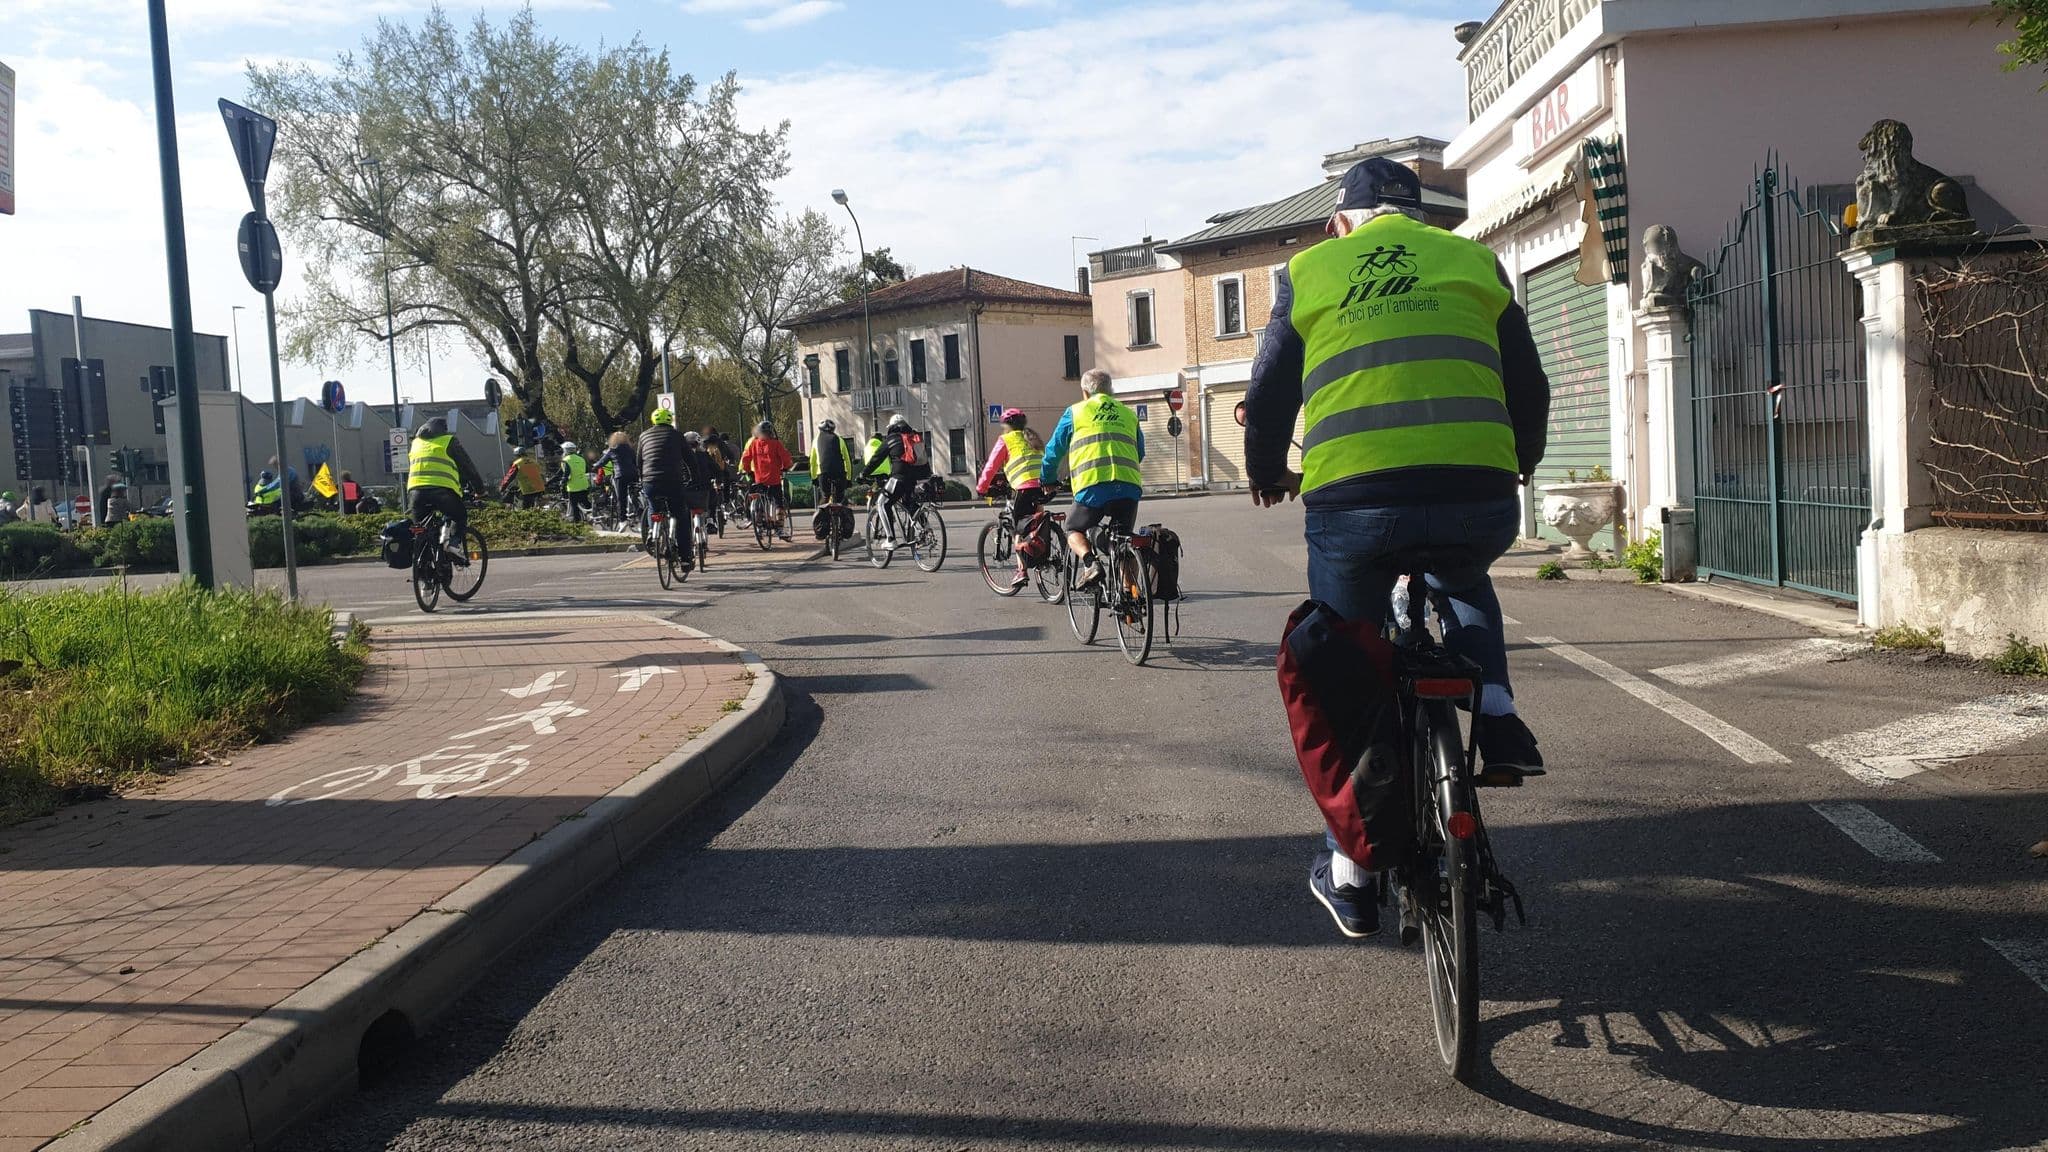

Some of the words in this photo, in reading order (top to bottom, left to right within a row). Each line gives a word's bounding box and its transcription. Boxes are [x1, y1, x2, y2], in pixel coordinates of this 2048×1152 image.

[1532, 83, 1570, 150] BAR
[1339, 276, 1419, 310] FIAB
[1337, 312, 1347, 328] in
[1348, 304, 1365, 324] bici
[1367, 301, 1384, 320] per
[1387, 295, 1440, 314] l'ambiente
